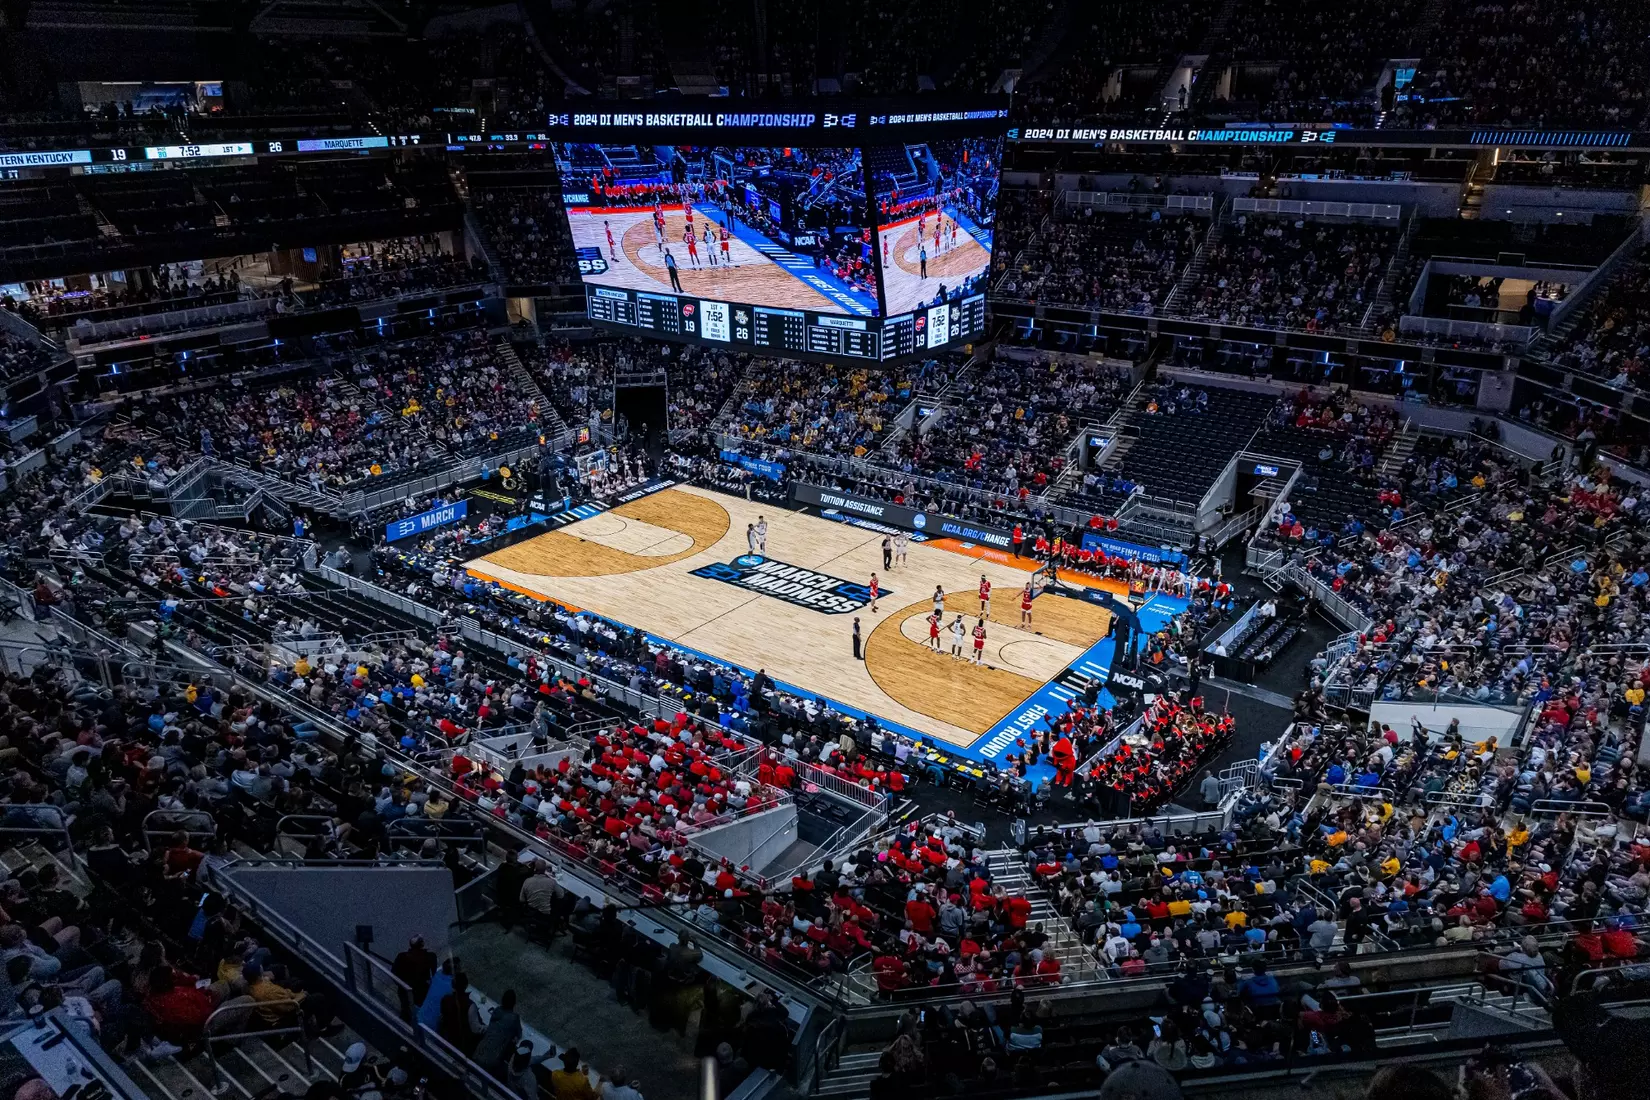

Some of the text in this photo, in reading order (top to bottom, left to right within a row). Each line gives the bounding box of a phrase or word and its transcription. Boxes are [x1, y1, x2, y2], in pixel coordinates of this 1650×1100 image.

[573, 113, 816, 127] 2024 DI MEN'S BASKETBALL CHAMPIONSHIP
[888, 115, 905, 124] 2024
[915, 113, 932, 122] MEN'S
[933, 112, 963, 121] BASKETBALL
[964, 110, 998, 120] CHAMPIONSHIP
[1024, 128, 1294, 142] 2024 DI MEN'S BASKETBALL CHAMPIONSHIP
[269, 141, 283, 153] 26
[324, 139, 364, 149] MARQUETTE
[111, 149, 127, 161] 19
[179, 145, 201, 157] 7:52
[25, 152, 74, 165] KENTUCKY
[794, 236, 816, 246] NCAA
[706, 310, 724, 323] 7:52
[684, 320, 696, 332] 19
[950, 323, 960, 337] 26
[736, 327, 749, 339] 26
[915, 334, 925, 348] 19
[618, 490, 645, 502] FIRST
[529, 500, 546, 511] NCAA
[820, 493, 845, 507] TUITION
[844, 499, 885, 517] ASSISTANCE
[421, 508, 455, 529] MARCH
[941, 523, 1011, 547] NCAA.ORG/CHANGE
[1121, 547, 1141, 559] FINAL
[751, 561, 845, 591] MARCH
[740, 573, 863, 613] MADNESS
[1112, 672, 1145, 691] NCAA
[978, 703, 1049, 759] FIRST ROUND
